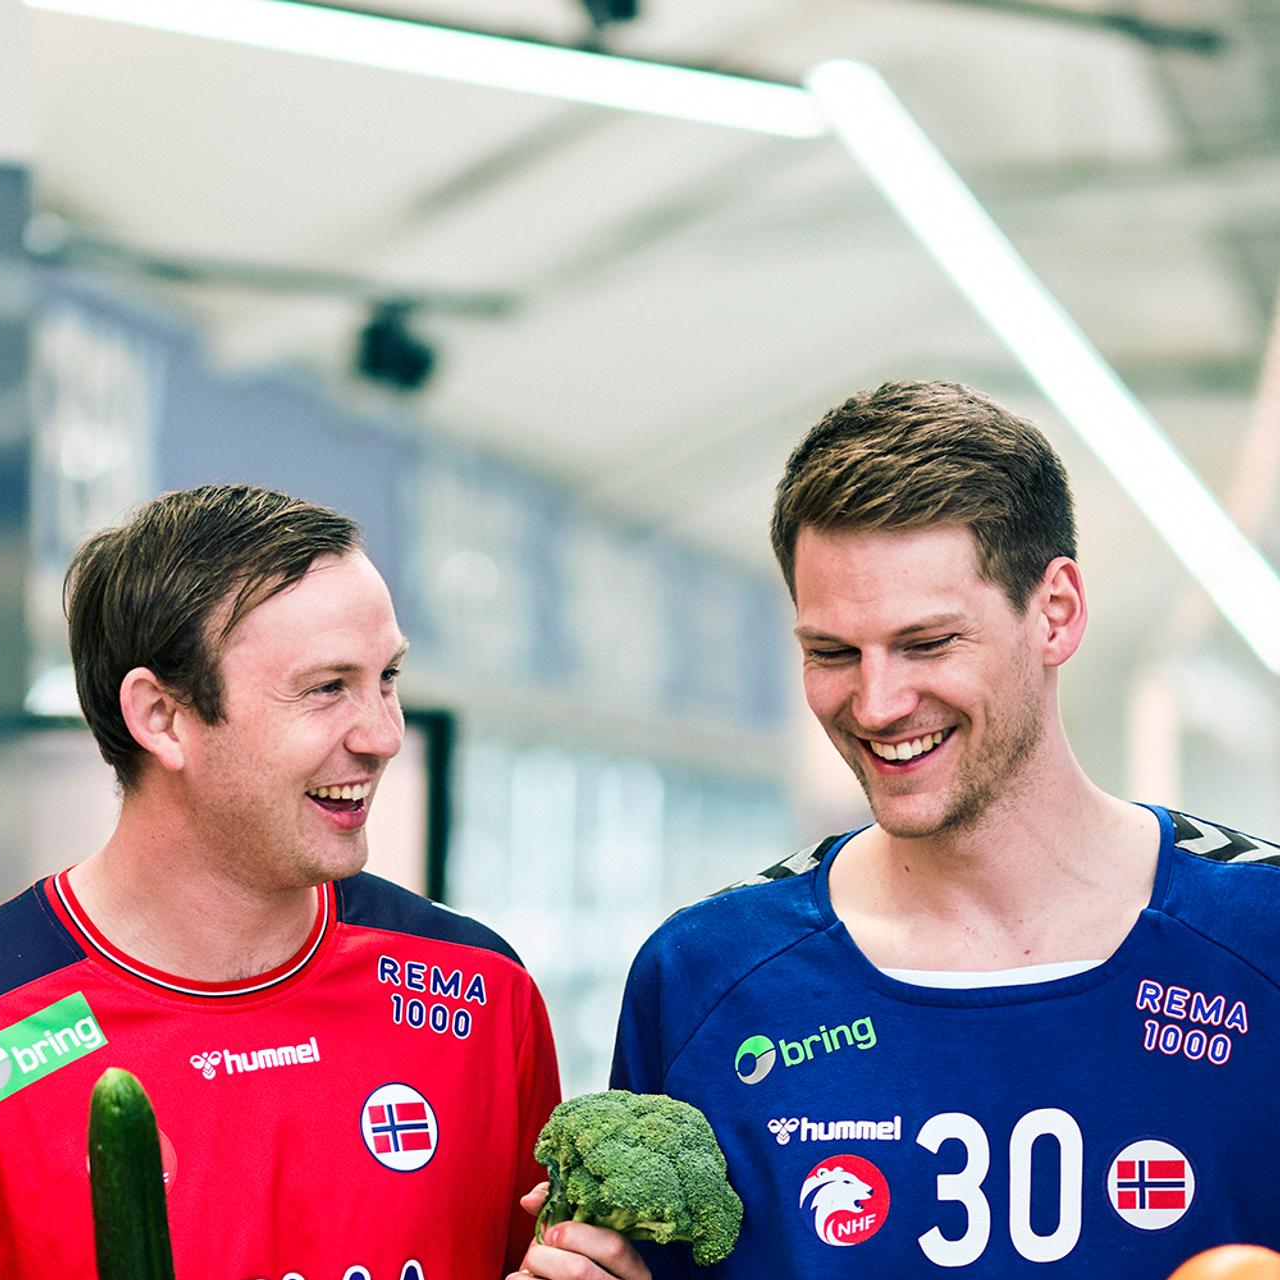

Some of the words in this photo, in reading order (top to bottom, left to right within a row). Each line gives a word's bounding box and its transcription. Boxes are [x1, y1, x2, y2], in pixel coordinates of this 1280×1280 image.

[378, 955, 487, 1006] REMA
[391, 994, 473, 1040] 1000
[1136, 979, 1248, 1033] REMA
[11, 1014, 103, 1076] bring
[224, 1037, 320, 1075] hummel
[779, 1016, 878, 1068] bring
[1143, 1019, 1232, 1065] 1000
[800, 1116, 902, 1143] hummel
[916, 1107, 1084, 1268] 30
[837, 1213, 877, 1237] NHF
